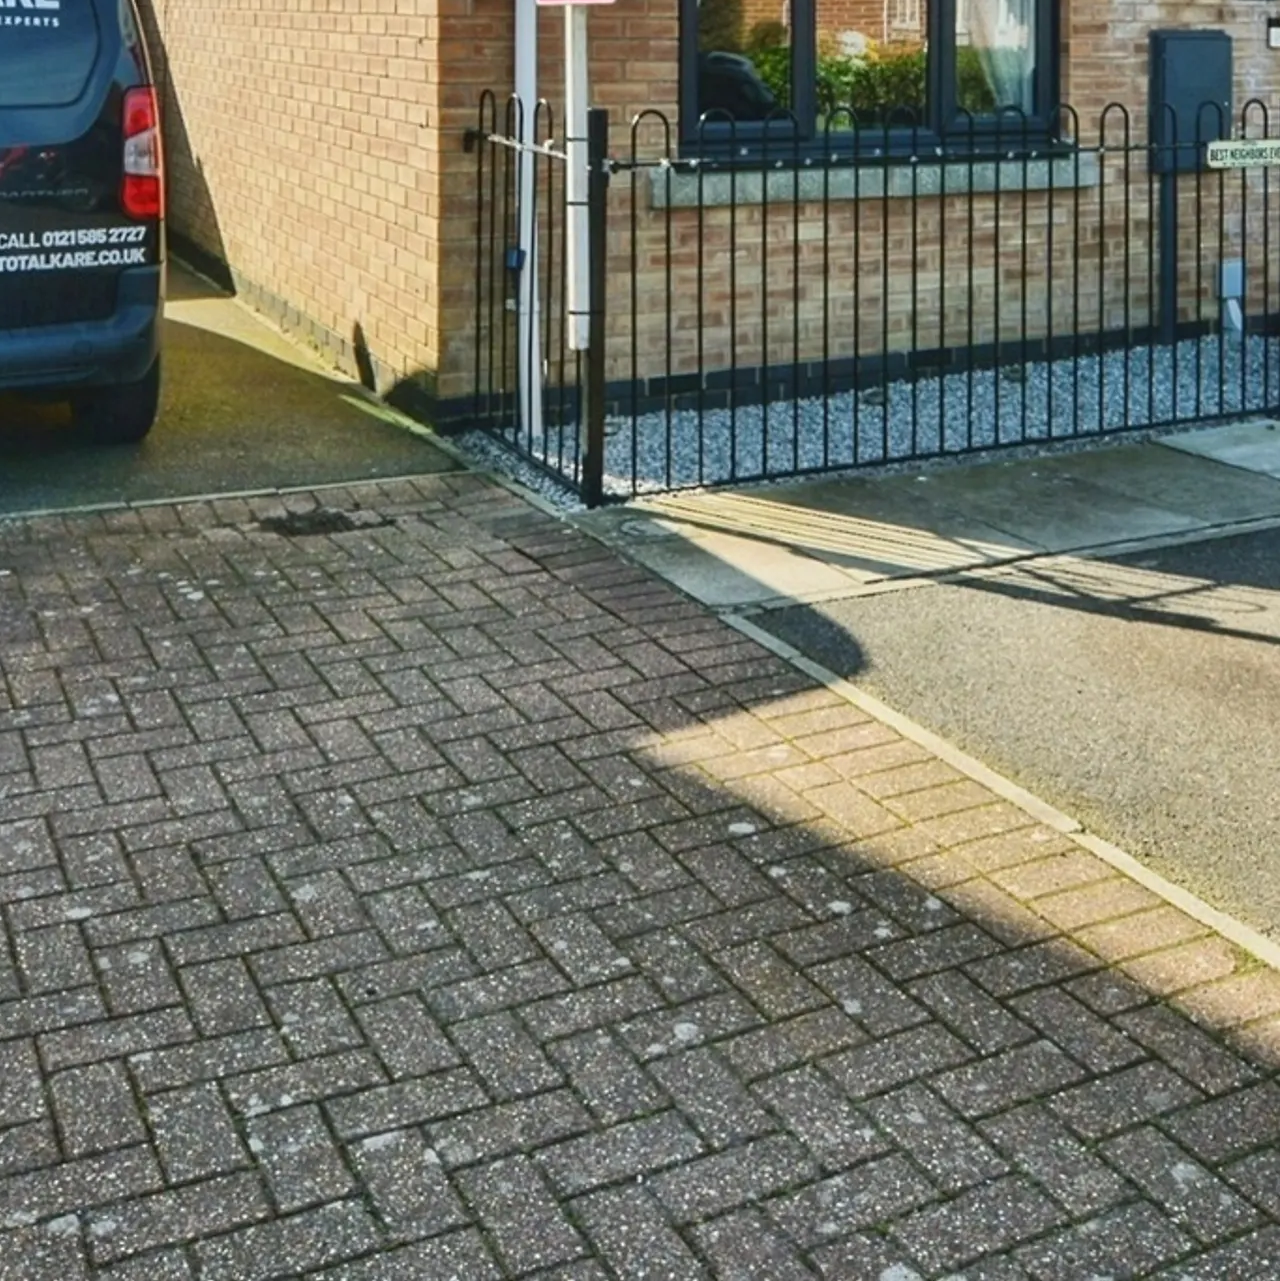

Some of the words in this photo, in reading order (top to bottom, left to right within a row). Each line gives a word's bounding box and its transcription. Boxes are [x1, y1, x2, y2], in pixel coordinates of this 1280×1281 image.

[1210, 148, 1228, 161] BEST
[42, 230, 76, 248] 0121
[107, 225, 147, 244] 2727
